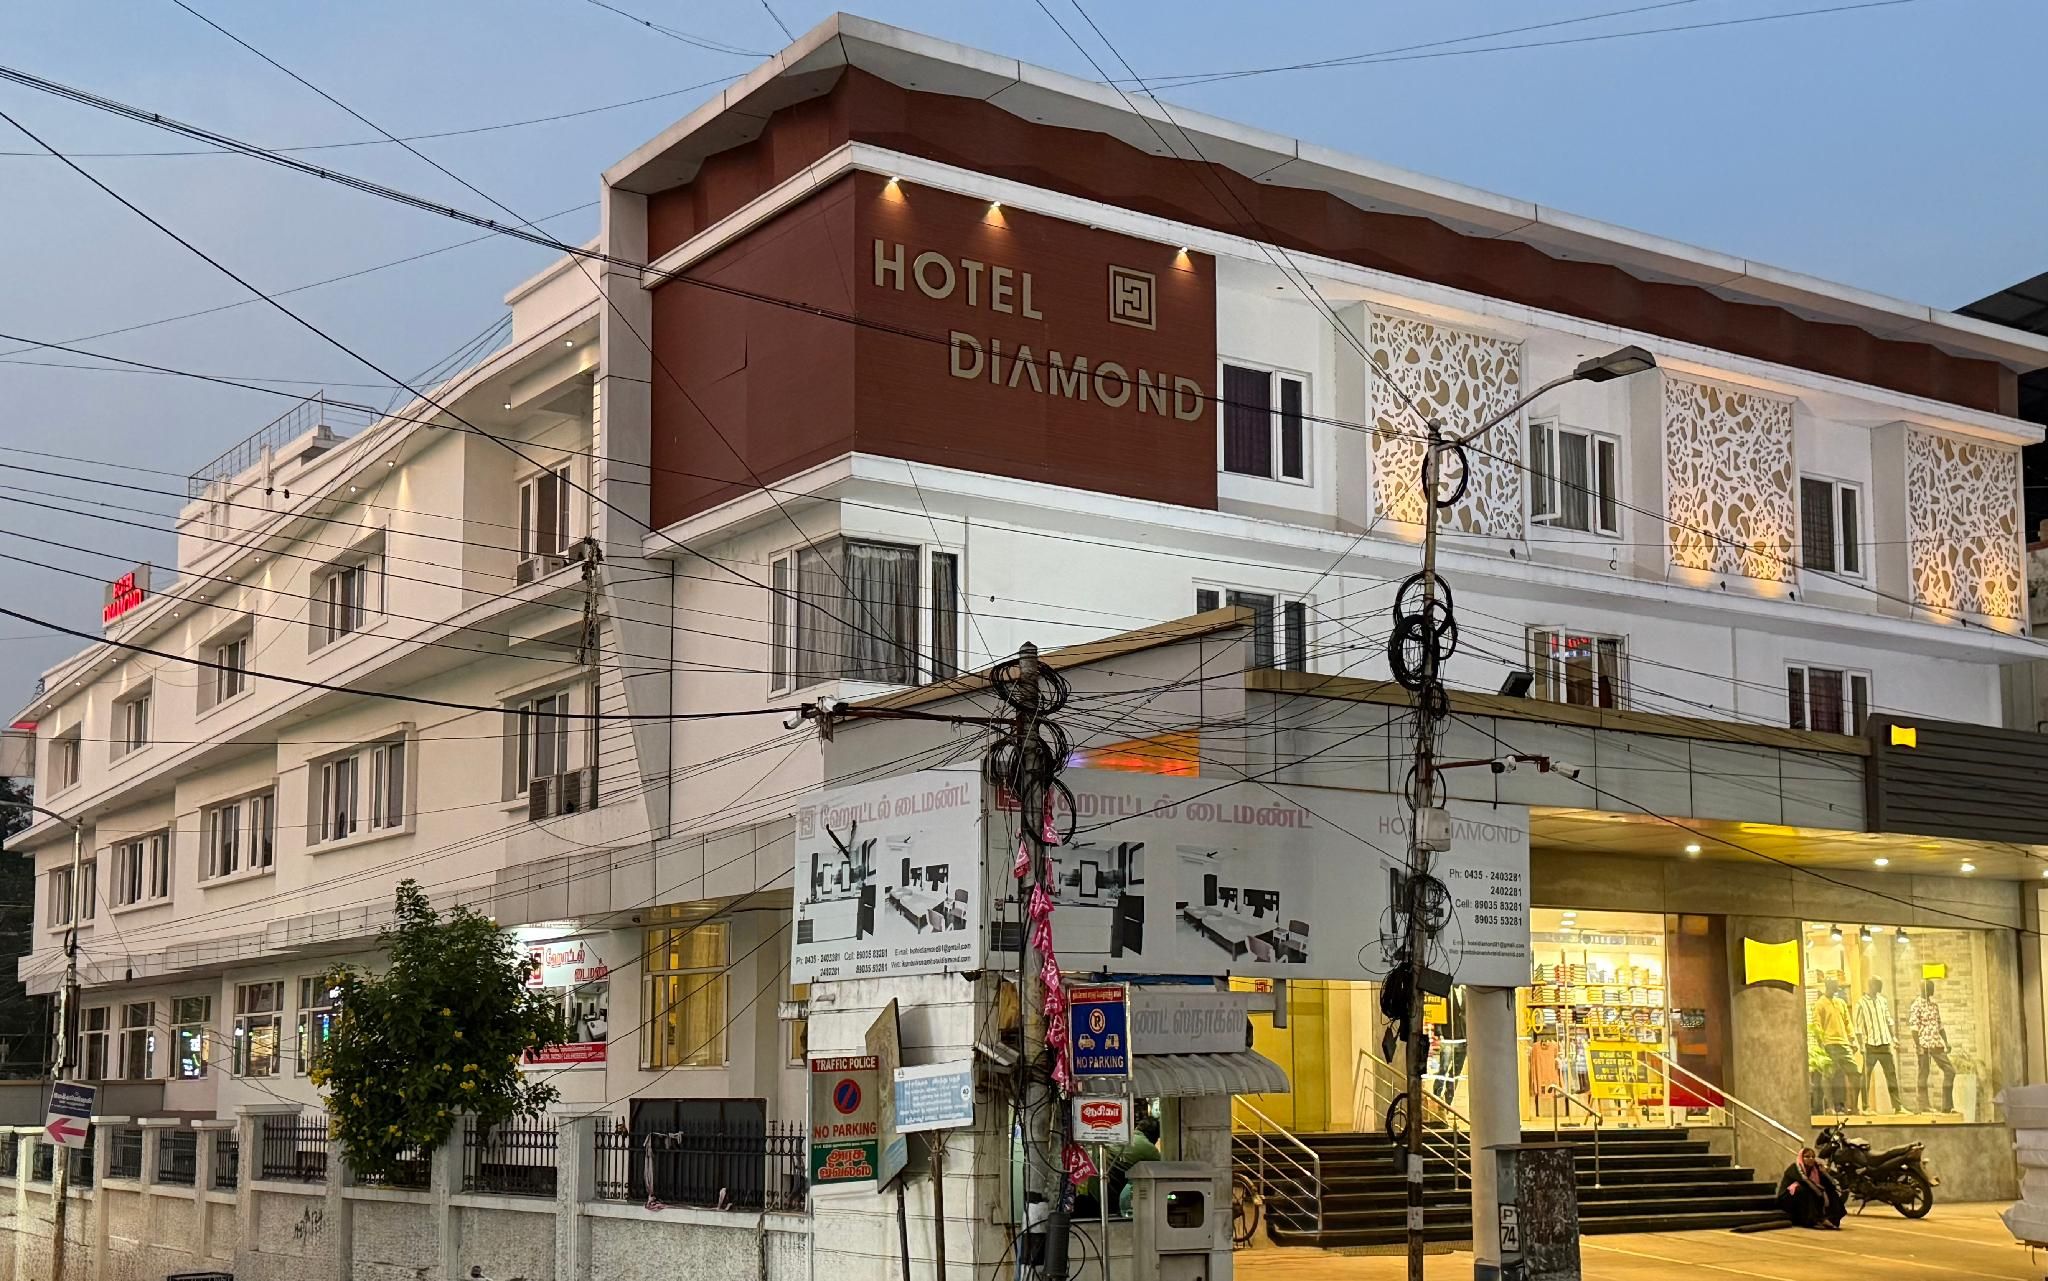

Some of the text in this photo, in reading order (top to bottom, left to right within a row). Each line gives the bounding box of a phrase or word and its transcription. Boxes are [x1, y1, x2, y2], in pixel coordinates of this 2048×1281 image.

[874, 239, 1043, 320] HOTEL
[950, 330, 1204, 421] DIAMOND
[1450, 822, 1521, 844] IAMOND
[1465, 870, 1483, 879] 0435
[1490, 871, 1522, 882] 2403281
[1490, 886, 1522, 896] 2402281
[1455, 899, 1522, 911] Cell: 89035 83281
[1475, 915, 1522, 926] 89035 53281
[816, 1057, 876, 1071] TRAFFIC POLICE
[1076, 1056, 1124, 1068] NO PARKING
[814, 1122, 877, 1139] NO PARKING
[1504, 1209, 1513, 1220] P
[1501, 1226, 1516, 1245] 74
